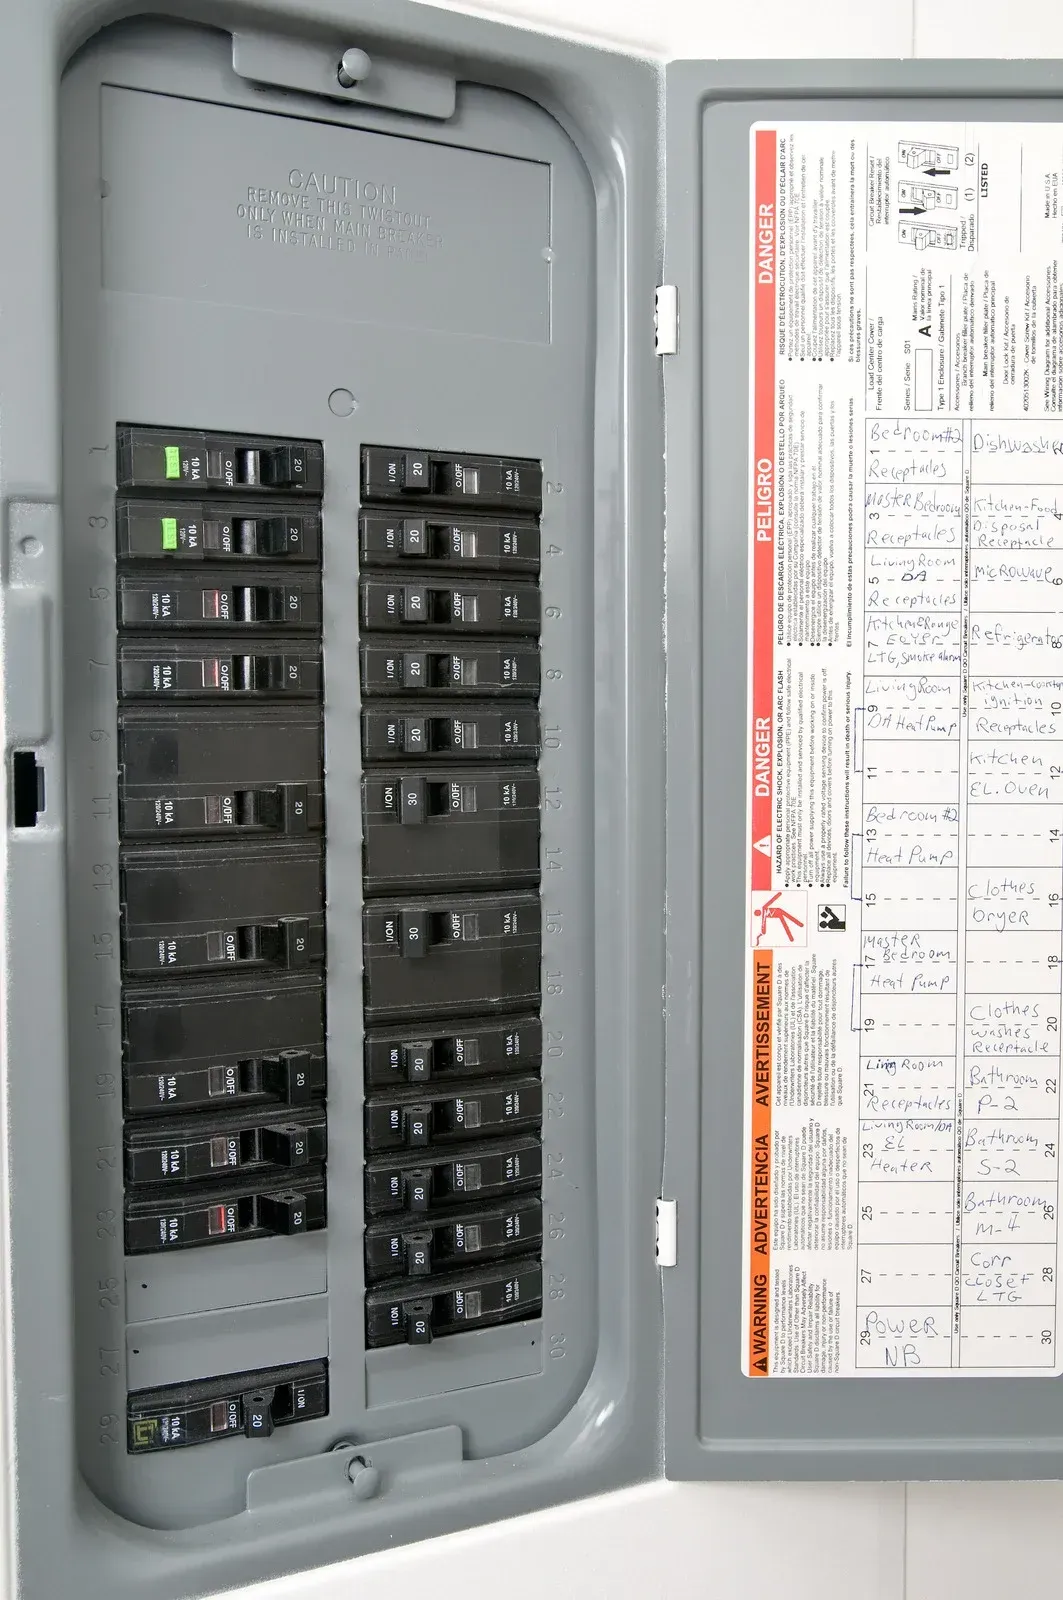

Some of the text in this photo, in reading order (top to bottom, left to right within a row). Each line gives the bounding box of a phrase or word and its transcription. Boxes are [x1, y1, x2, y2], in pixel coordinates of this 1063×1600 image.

[964, 153, 975, 166] (2)
[288, 169, 396, 205] CAUTION
[964, 188, 975, 201] (1)
[248, 186, 431, 230] REMOVE THIS TWISTOUT
[237, 204, 443, 248] ONLY WHEN MAIN BREAKER
[248, 224, 263, 240] IS
[272, 228, 355, 252] INSTALLED
[365, 242, 379, 257] IN
[758, 203, 774, 284] DANGER
[918, 325, 931, 338] A
[191, 456, 200, 480] 10 kA
[294, 458, 303, 472] 20
[413, 462, 423, 476] 20
[869, 459, 946, 482] Receptacles
[225, 460, 234, 486] O/OFF
[455, 464, 463, 487] O/OFF
[505, 469, 513, 490] 10 kA
[546, 481, 564, 494] 2
[757, 458, 772, 542] PELIGRO
[89, 516, 109, 529] 3
[223, 526, 231, 552] O/OFF
[290, 528, 298, 542] 20
[410, 530, 419, 543] 20
[867, 524, 956, 545] Receptacles
[978, 534, 1054, 548] Receptacle
[546, 544, 563, 556] 4
[89, 587, 111, 599] 5
[868, 590, 956, 608] Receptacles
[289, 595, 298, 610] 20
[411, 596, 421, 609] 20
[545, 606, 562, 619] 6
[289, 665, 298, 679] 20
[546, 669, 563, 680] 8
[868, 704, 878, 712] 9
[1051, 702, 1061, 716] 10
[976, 717, 1056, 735] Receptacles
[543, 724, 562, 749] 10
[755, 717, 770, 797] DANGER
[1050, 765, 1061, 780] 12
[408, 792, 417, 805] 30
[545, 786, 562, 811] 12
[866, 807, 959, 823] Bedroom #2
[867, 829, 877, 842] 13
[1050, 829, 1059, 842] 14
[93, 863, 113, 890] 13
[866, 893, 876, 907] 15
[1049, 893, 1059, 907] 16
[545, 910, 563, 934] 16
[386, 921, 394, 942] I/ON
[409, 927, 419, 940] 30
[226, 935, 236, 961] O/OFF
[296, 938, 305, 951] 20
[865, 955, 875, 968] 17
[865, 1018, 875, 1032] 19
[1047, 1016, 1058, 1032] 20
[755, 962, 770, 1107] AVERTISSEMENT
[296, 1073, 305, 1087] 20
[1046, 1079, 1057, 1093] 22
[867, 1095, 951, 1112] Receptacles
[1045, 1143, 1056, 1157] 24
[754, 1134, 768, 1255] ADVERTENCIA
[415, 1251, 425, 1265] 20
[1043, 1267, 1053, 1282] 28
[549, 1273, 566, 1300] 28
[753, 1274, 767, 1355] WARNING
[860, 1330, 871, 1345] 29
[1041, 1329, 1051, 1344] 30
[550, 1333, 566, 1359] 30
[100, 1413, 119, 1444] 29
[252, 1414, 263, 1428] 20
